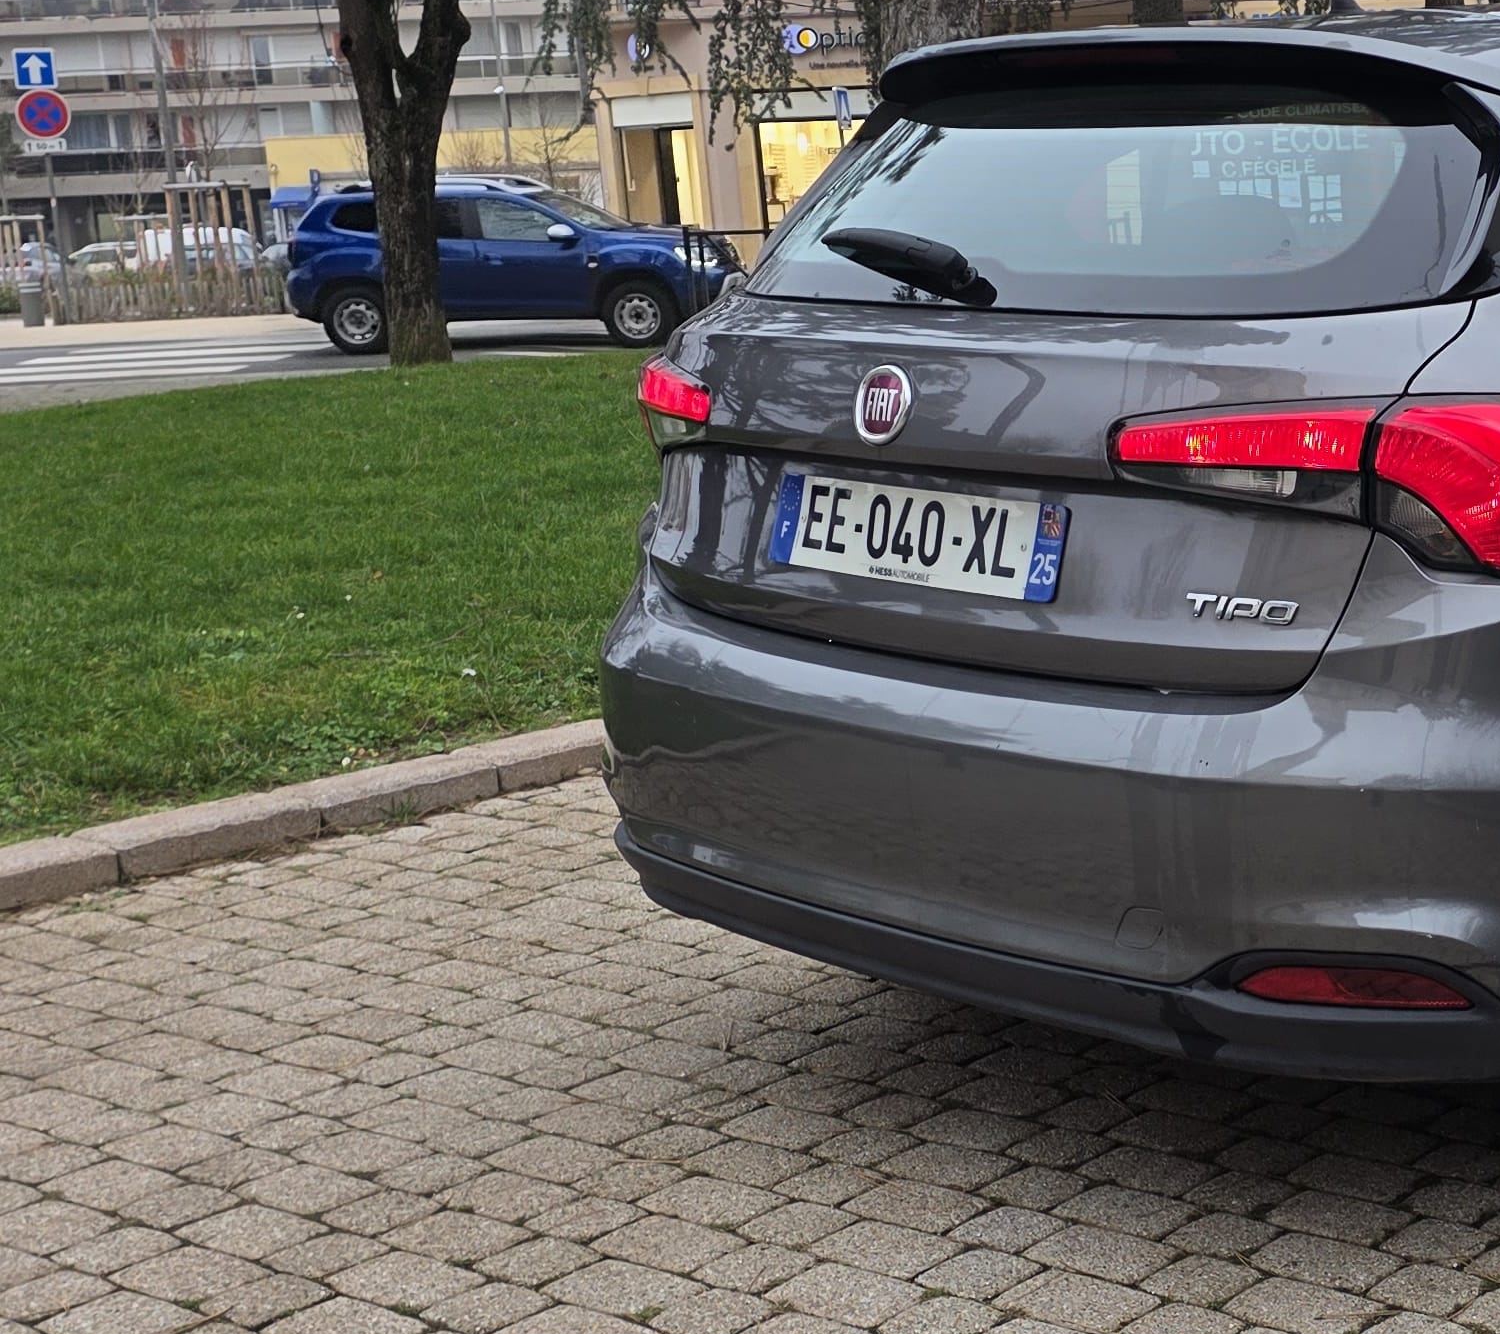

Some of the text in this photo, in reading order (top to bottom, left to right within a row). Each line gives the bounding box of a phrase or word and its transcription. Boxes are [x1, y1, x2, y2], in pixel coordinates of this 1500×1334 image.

[865, 387, 899, 422] FIAT
[780, 485, 1016, 579] F EE-040-XL
[1028, 553, 1057, 585] 25
[1185, 592, 1300, 625] TIPO
